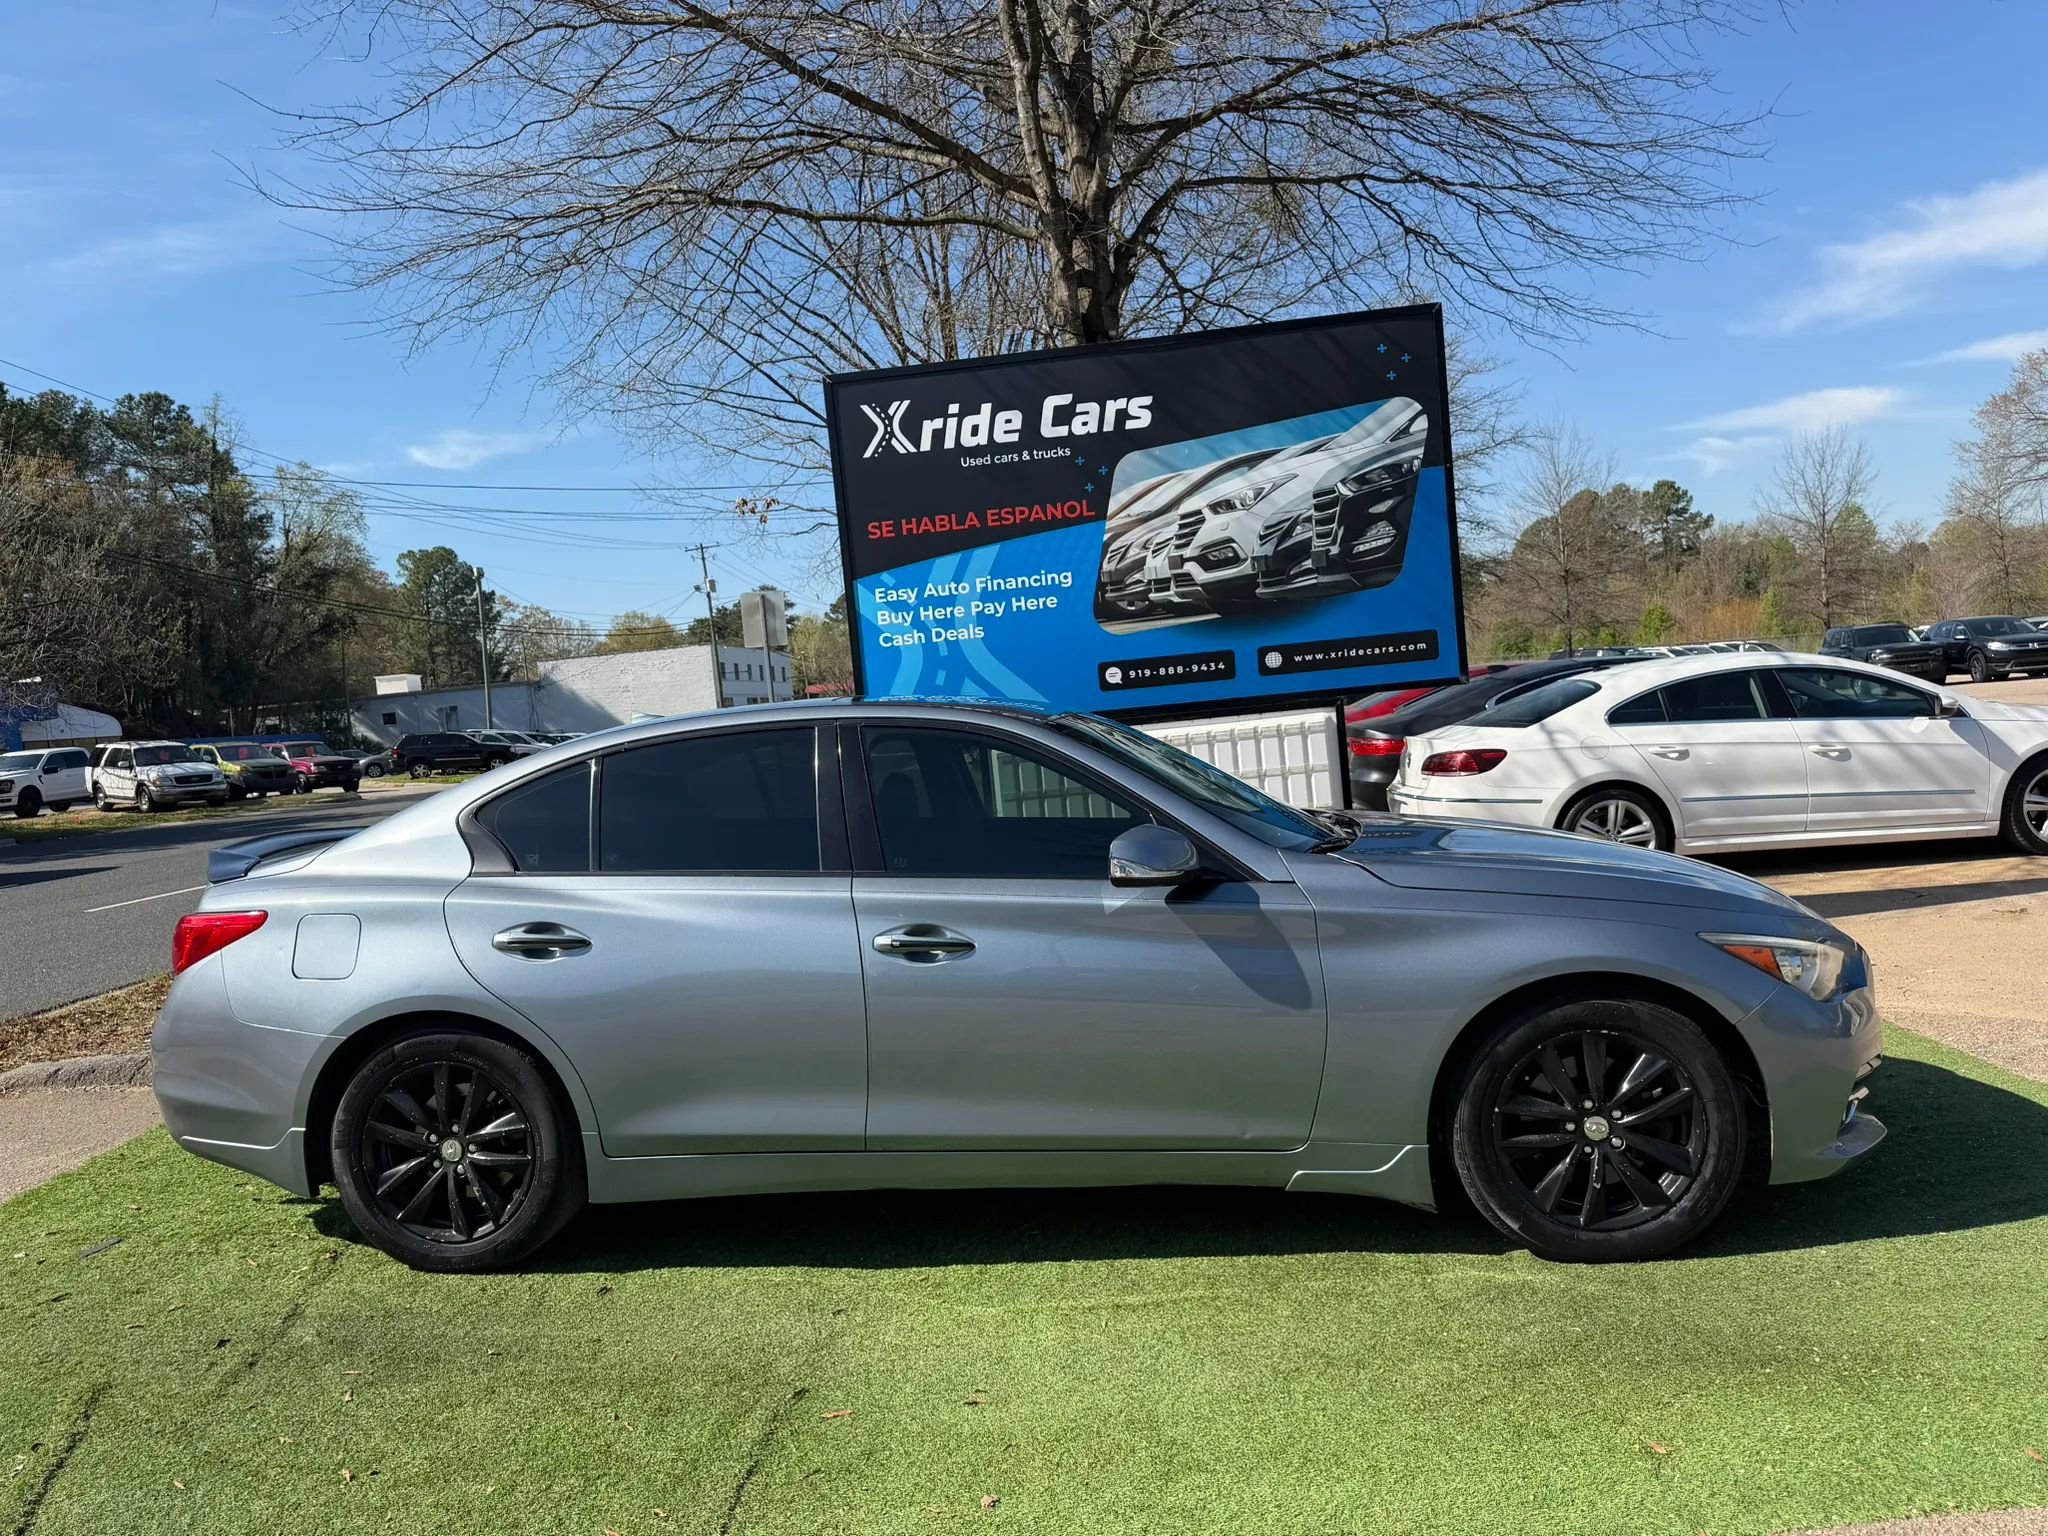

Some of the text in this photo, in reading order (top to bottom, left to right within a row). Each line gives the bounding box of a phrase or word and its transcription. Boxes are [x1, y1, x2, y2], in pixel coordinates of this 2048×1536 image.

[1040, 393, 1154, 439] Cars
[960, 446, 1071, 467] Used cars & trucks
[867, 499, 1096, 540] SE HABLA ESPANOL
[874, 569, 1073, 604] Easy Auto Financing
[876, 596, 1058, 626] Buy Here Pay Here
[878, 623, 985, 648] Cash Deals
[1293, 641, 1428, 662] www.xridecars.com
[1128, 661, 1226, 679] 919-888-9434
